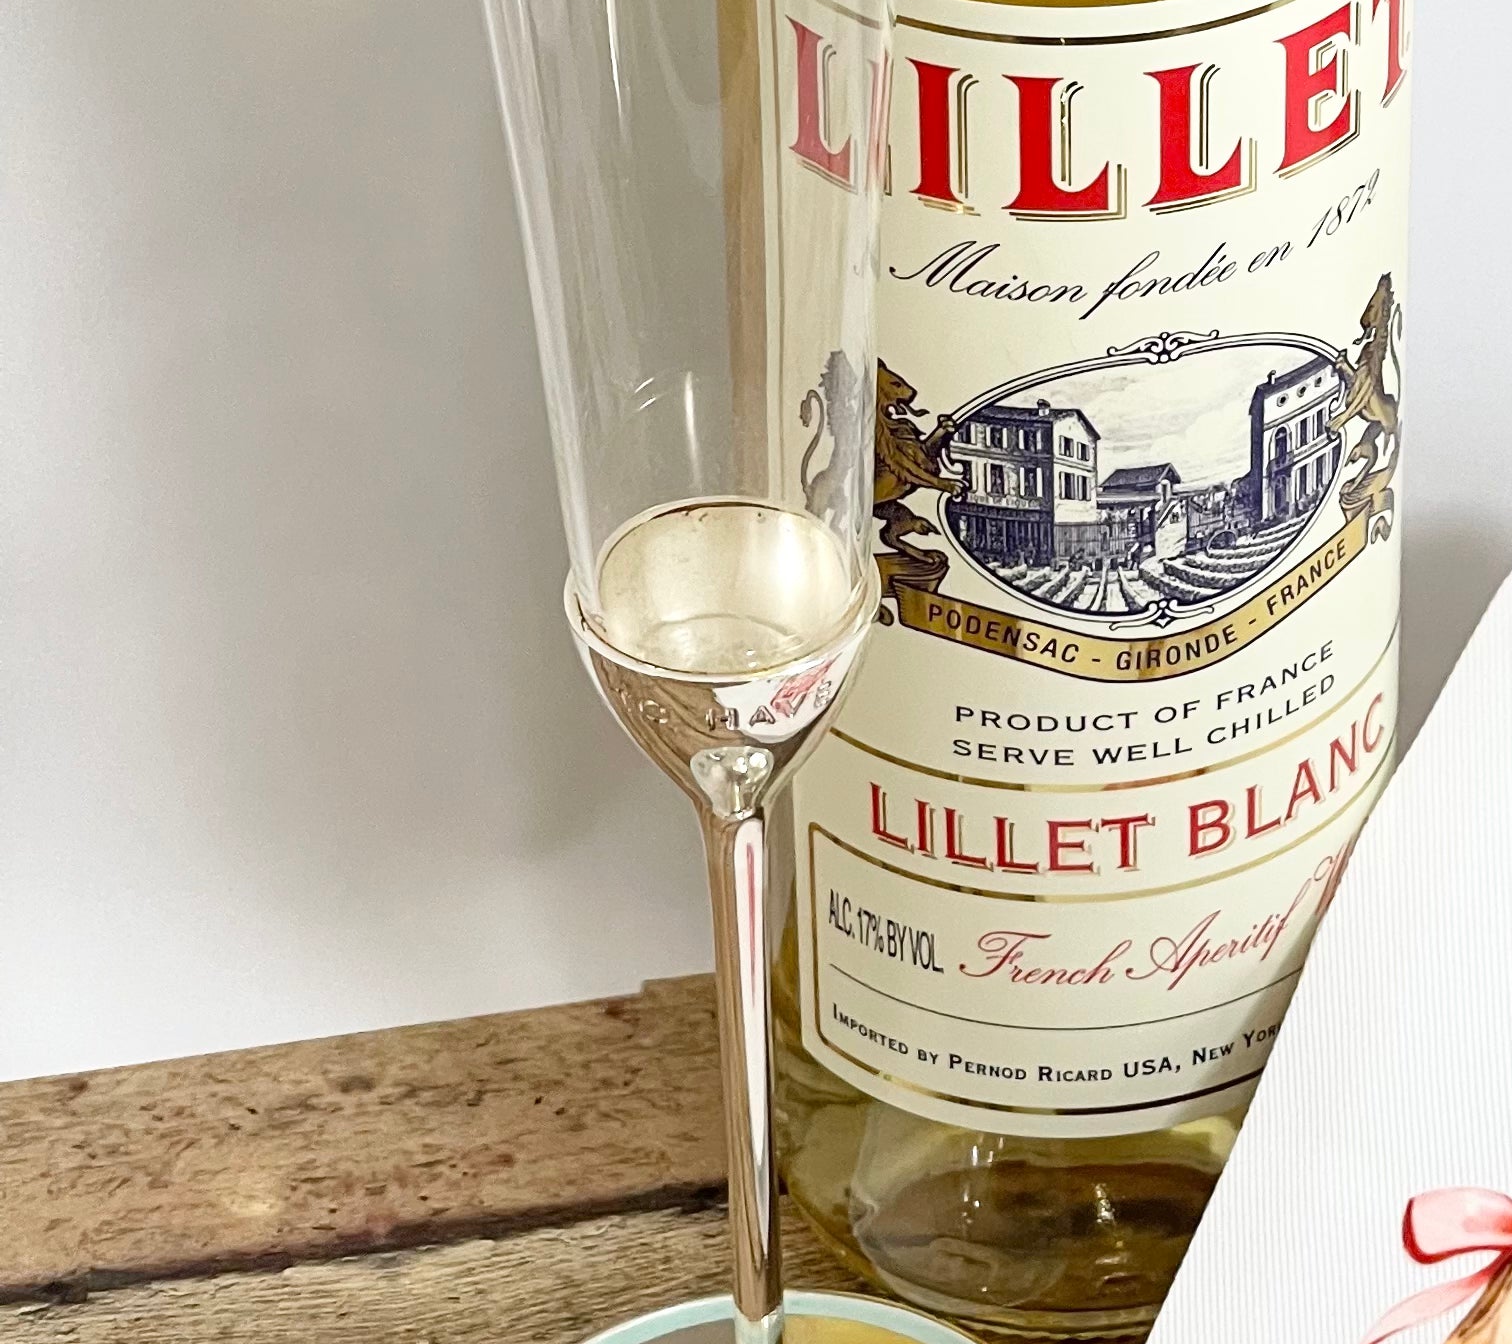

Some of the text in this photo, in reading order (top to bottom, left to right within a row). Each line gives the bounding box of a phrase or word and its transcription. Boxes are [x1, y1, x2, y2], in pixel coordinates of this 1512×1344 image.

[889, 168, 1382, 319] Maison fondée en 1872
[928, 604, 1080, 664] PODENSAC
[1116, 623, 1238, 671] GIRONDE
[1266, 538, 1348, 616] FRANCE
[953, 674, 1336, 766] SERVE WELL CHILLED
[954, 640, 1335, 733] PRODUCT OF FRANCE
[869, 693, 1385, 874] LILLET BLANC
[857, 907, 885, 953] 17%
[886, 919, 908, 961] BY
[959, 930, 1132, 984] French
[1125, 878, 1312, 990] Aperitif
[1123, 1057, 1182, 1078] USA,
